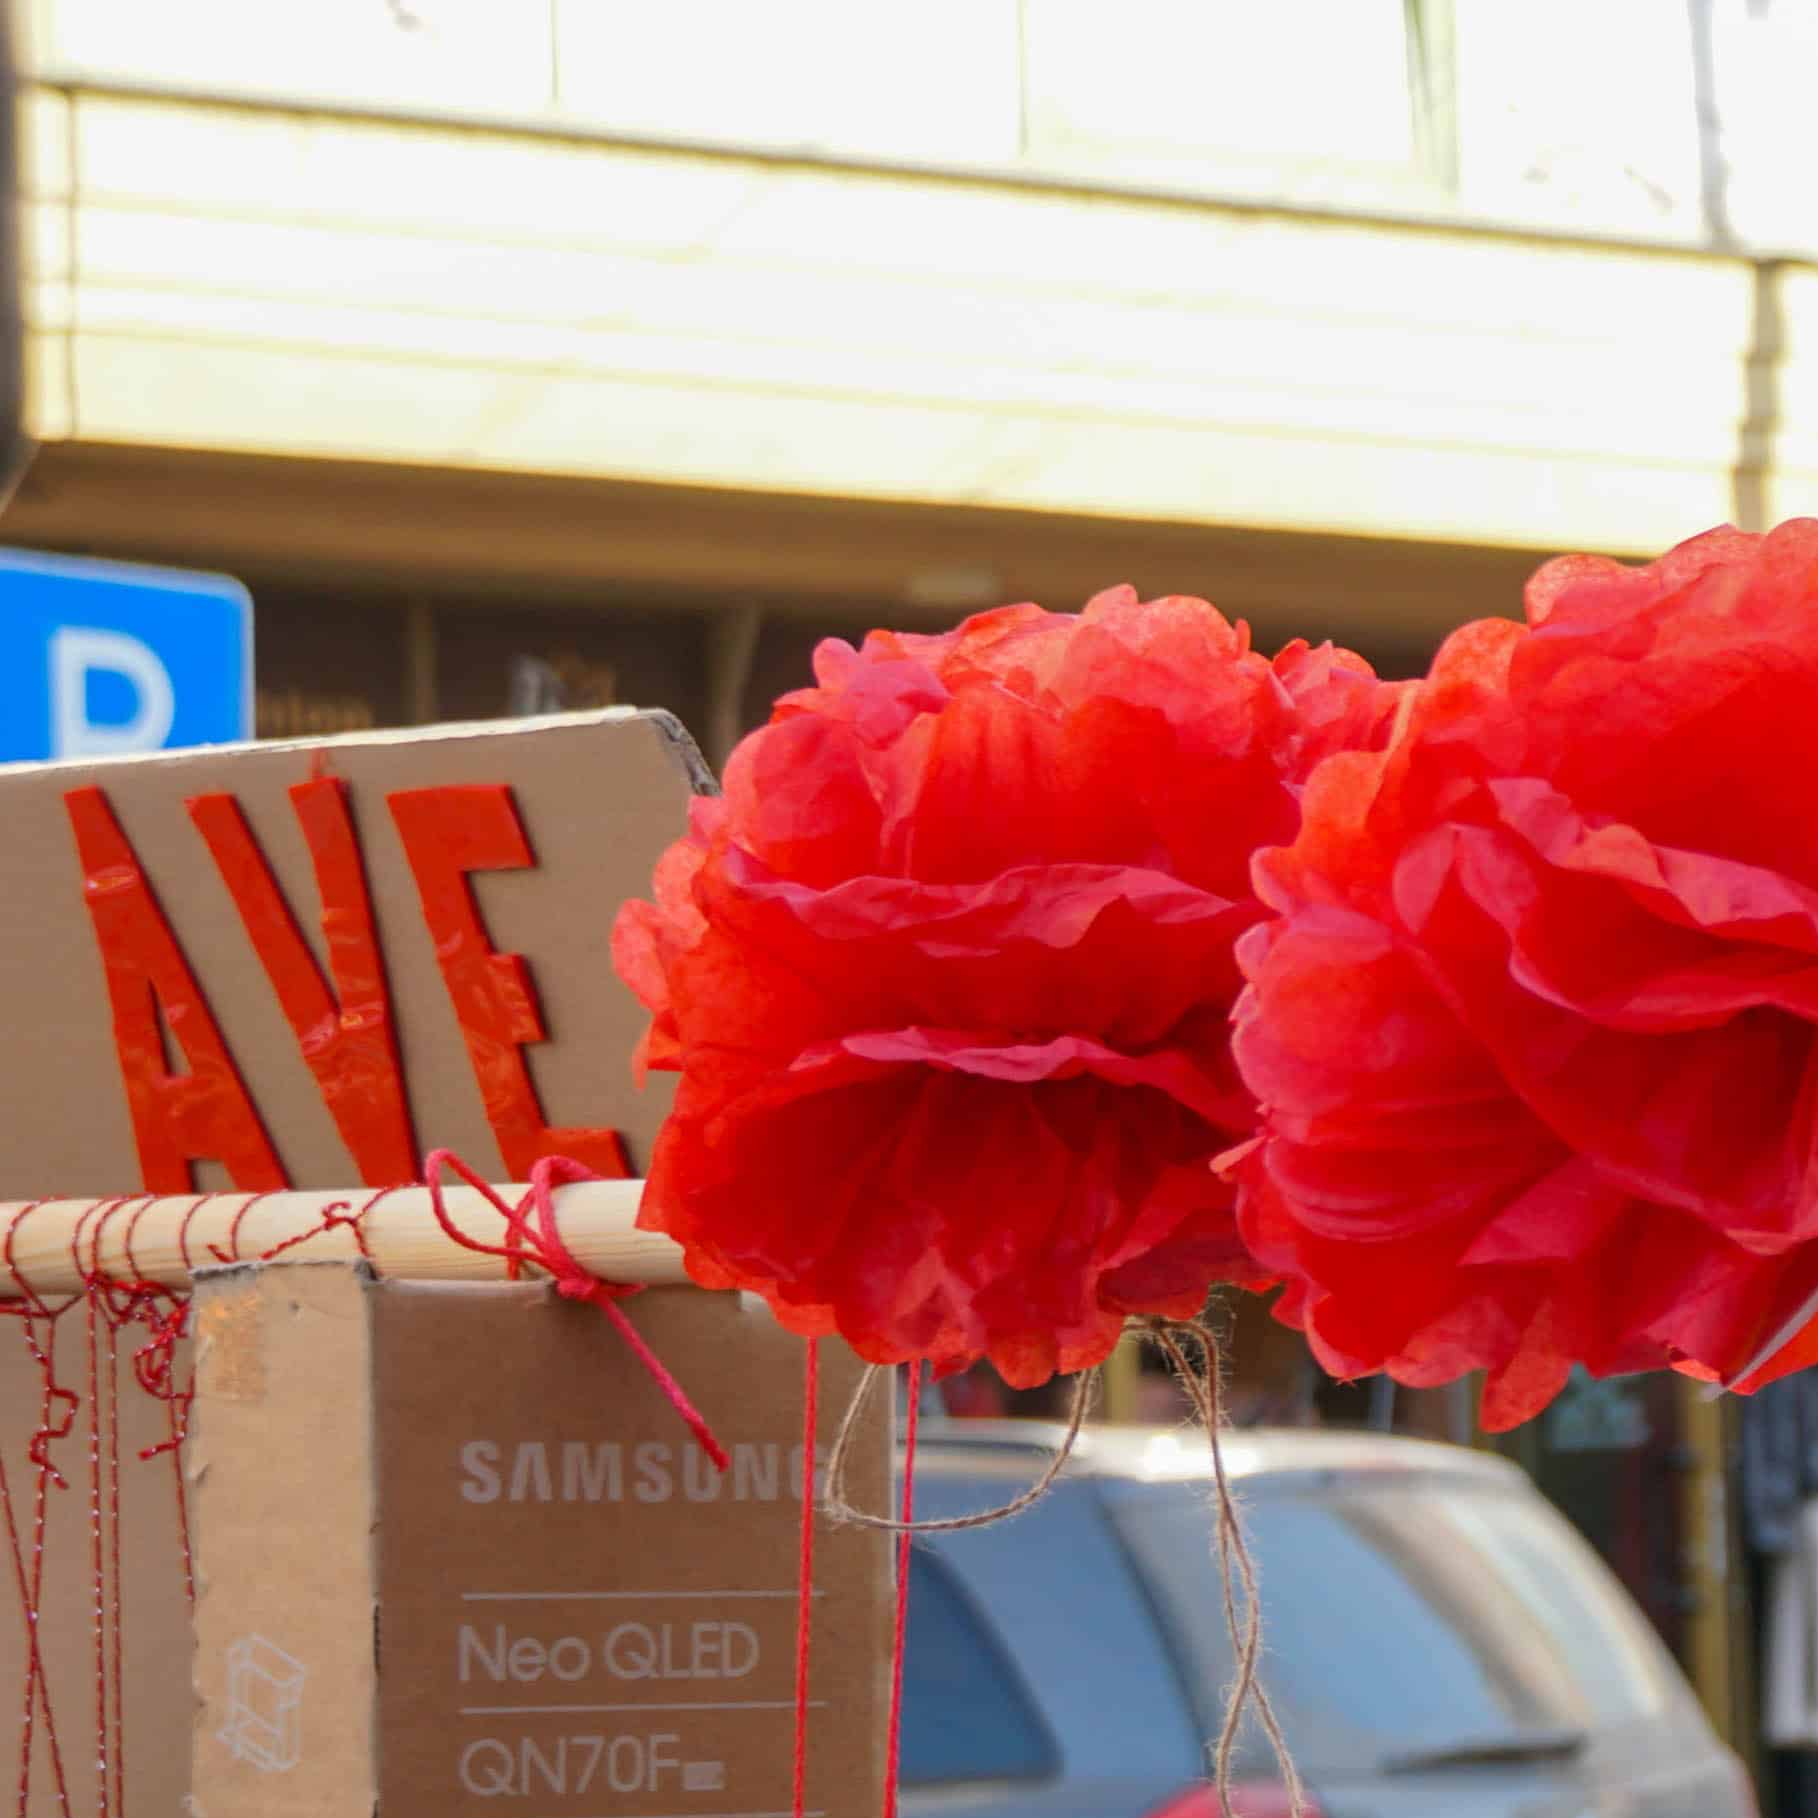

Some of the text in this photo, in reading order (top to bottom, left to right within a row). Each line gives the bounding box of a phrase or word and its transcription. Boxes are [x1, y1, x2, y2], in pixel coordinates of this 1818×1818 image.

[48, 627, 175, 757] P
[63, 776, 640, 1196] AVE
[460, 1440, 831, 1504] SAMSUNG
[458, 1622, 759, 1682] Neo QLED
[459, 1735, 681, 1796] QN70F
